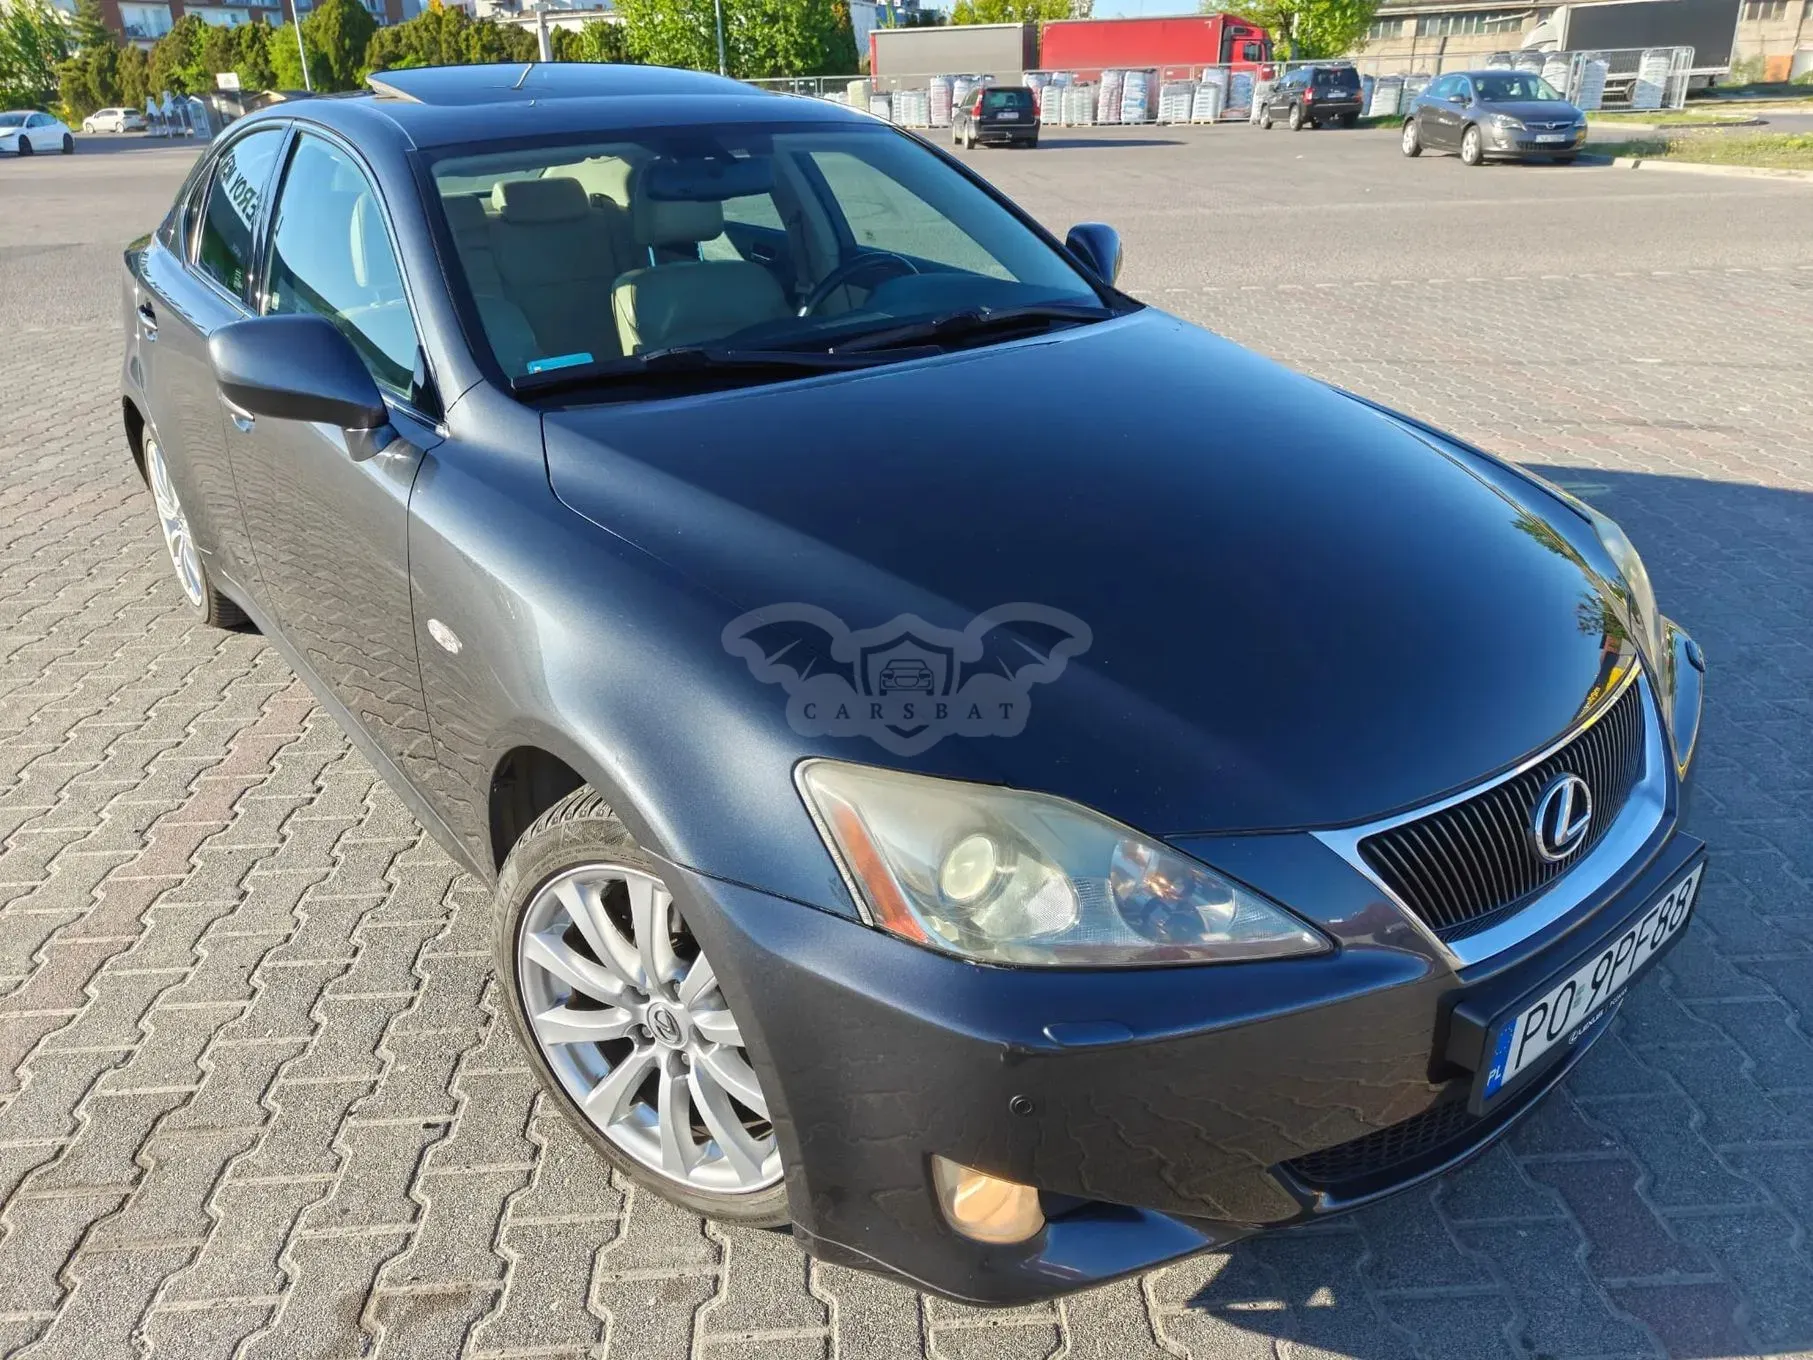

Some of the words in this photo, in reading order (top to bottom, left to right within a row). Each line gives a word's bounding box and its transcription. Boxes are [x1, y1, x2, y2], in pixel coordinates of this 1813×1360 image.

[1514, 980, 1577, 1069] PO
[1582, 876, 1694, 1016] 9PF88
[1486, 1064, 1503, 1087] PL
